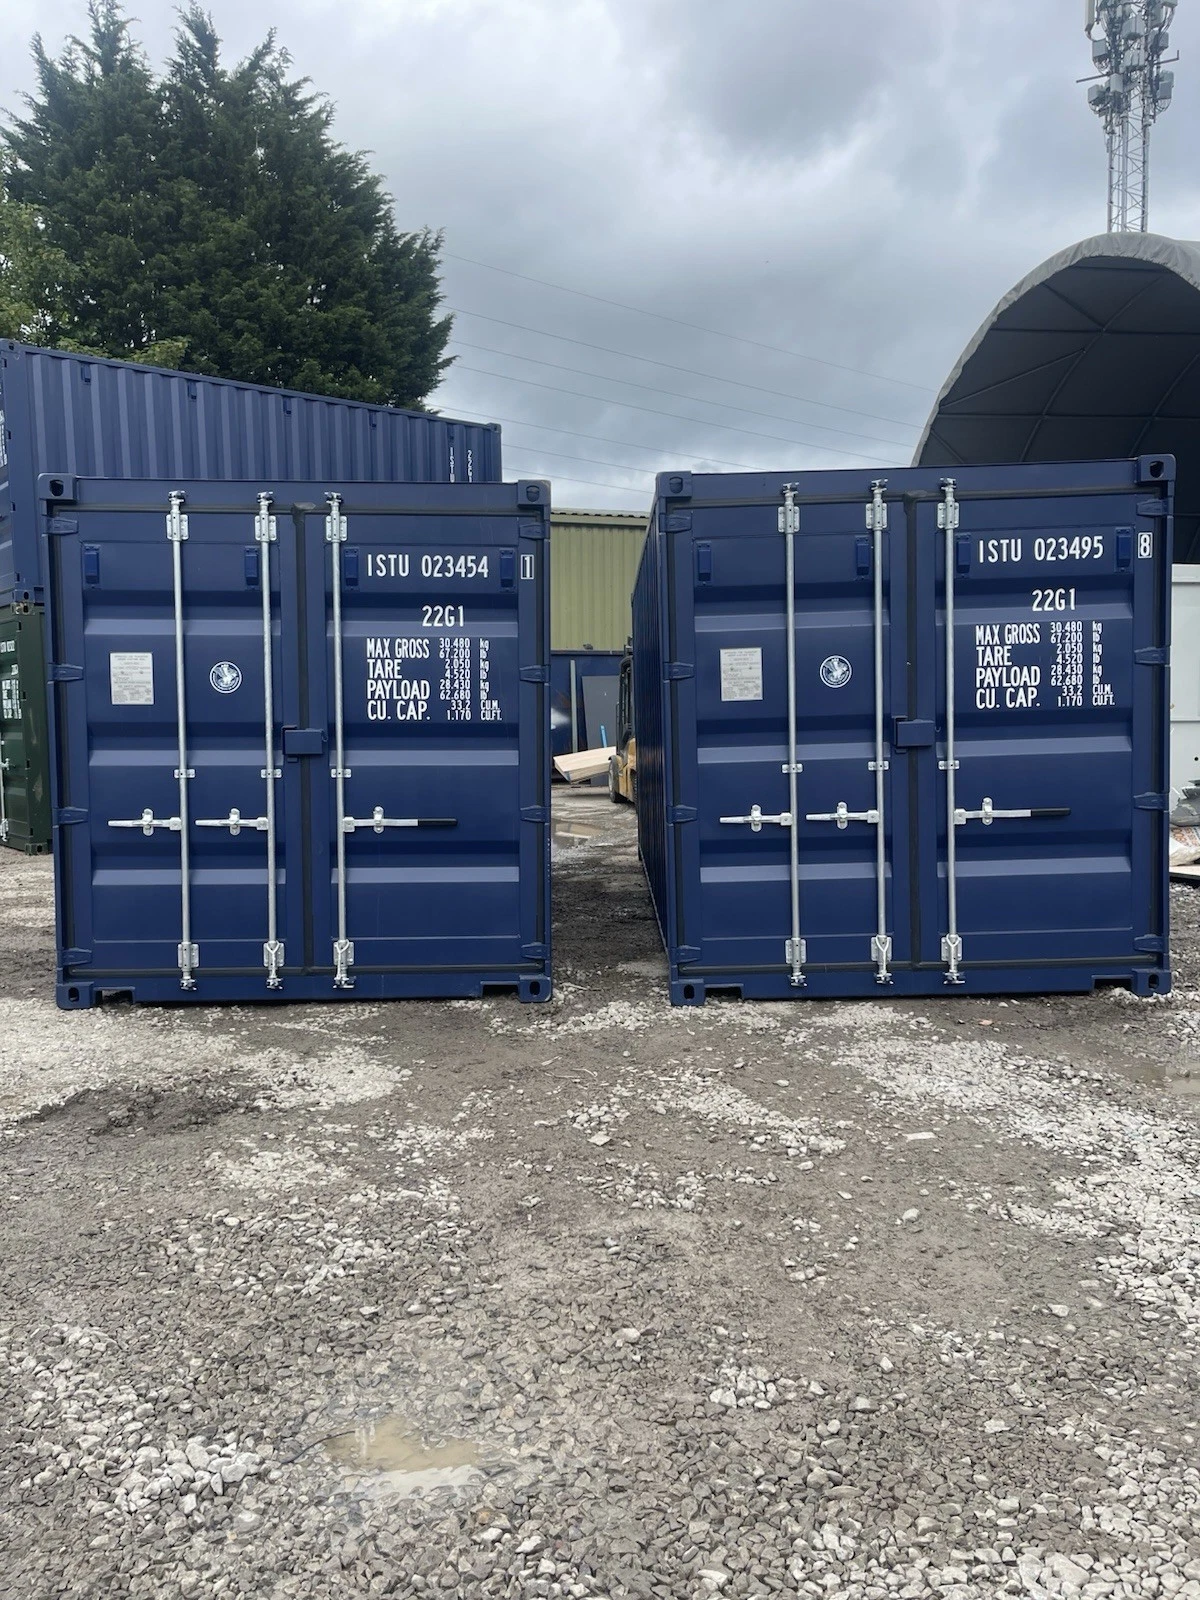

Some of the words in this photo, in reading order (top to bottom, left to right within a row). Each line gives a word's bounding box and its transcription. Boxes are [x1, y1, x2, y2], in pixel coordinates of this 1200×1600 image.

[978, 539, 1022, 563] ISTU
[1034, 536, 1103, 561] 023495
[368, 554, 410, 577] ISTU
[421, 555, 489, 578] 023454
[1032, 588, 1076, 611] 22G1
[422, 605, 464, 627] 22G1
[975, 625, 1003, 645] MAX
[1005, 624, 1040, 644] GROSS
[1050, 621, 1083, 632] 30.480
[1093, 622, 1103, 633] kg
[1050, 633, 1083, 643] 67.200
[1093, 633, 1100, 641] lb
[367, 638, 393, 658] MAX
[395, 639, 430, 659] GROSS
[439, 638, 470, 648] 30.480
[480, 639, 489, 650] kg
[439, 649, 470, 658] 67.200
[480, 650, 487, 658] lb
[976, 646, 1012, 666] TARE
[1056, 643, 1083, 653] 2.050
[1093, 644, 1103, 655] kg
[1056, 654, 1083, 664] 4.520
[1093, 654, 1100, 663] lb
[367, 659, 402, 679] TARE
[445, 660, 471, 669] 2.050
[480, 660, 489, 671] kg
[445, 670, 471, 679] 4.520
[480, 670, 487, 679] lb
[976, 667, 1040, 687] PAYLOAD
[1051, 665, 1083, 675] 28.430
[1093, 665, 1103, 676] kg
[367, 680, 430, 699] PAYLOAD
[439, 680, 471, 689] 28.430
[480, 681, 489, 692] kg
[1051, 675, 1083, 685] 62.680
[1093, 676, 1100, 684] lb
[440, 690, 471, 699] 62.680
[480, 691, 487, 699] lb
[976, 688, 1001, 708] CU.
[1006, 688, 1040, 707] CAP.
[1057, 696, 1083, 706] 1.170
[367, 701, 391, 720] CU.
[396, 702, 430, 720] CAP.
[447, 710, 471, 720] 1.170
